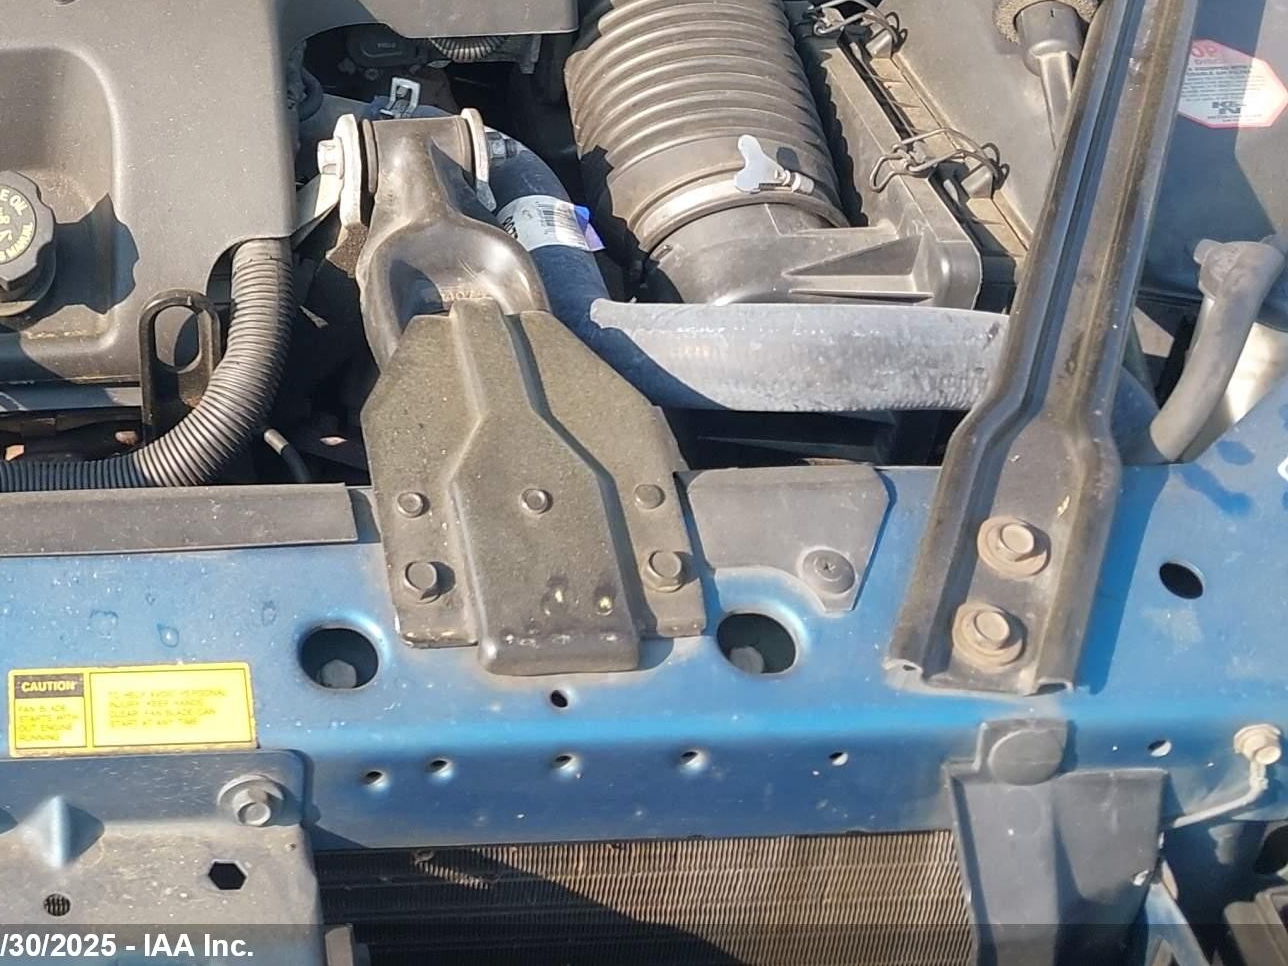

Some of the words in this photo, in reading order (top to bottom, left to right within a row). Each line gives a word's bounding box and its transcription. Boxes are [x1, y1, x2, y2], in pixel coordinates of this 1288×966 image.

[10, 194, 28, 216] OIL
[5, 221, 33, 258] MANUAL
[20, 680, 77, 693] CAUTION
